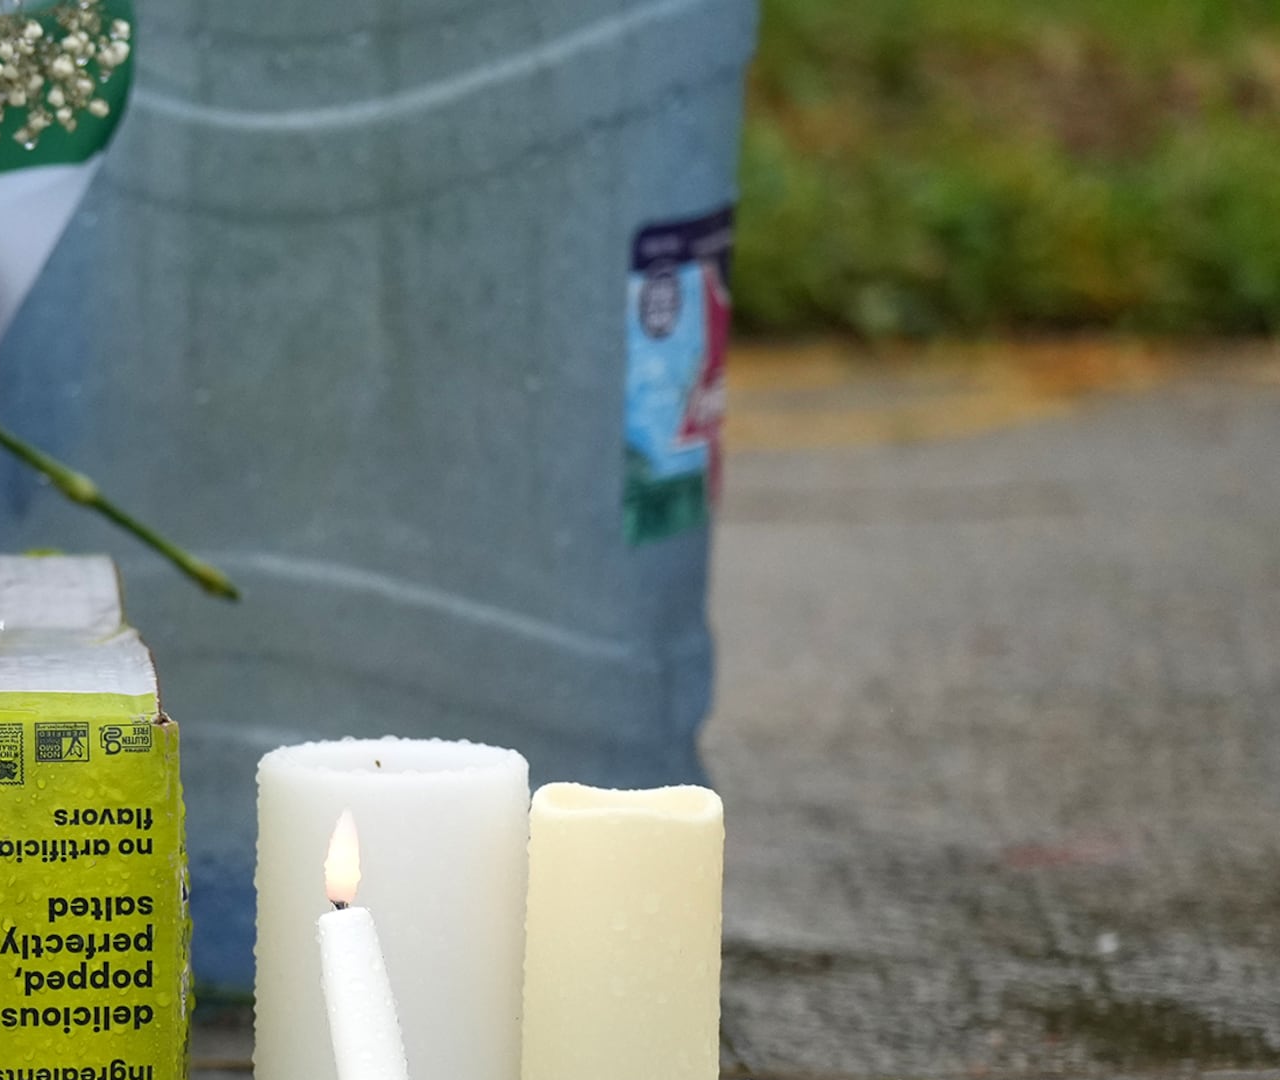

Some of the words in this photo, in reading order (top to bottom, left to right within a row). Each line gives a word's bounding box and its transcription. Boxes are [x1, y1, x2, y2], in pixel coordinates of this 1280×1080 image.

[122, 736, 149, 744] GLUTEN
[133, 727, 148, 735] FREE
[55, 807, 153, 829] flavors
[118, 839, 153, 857] no
[48, 897, 153, 922] salted
[0, 926, 153, 959] perfectly
[14, 961, 153, 995] popped,
